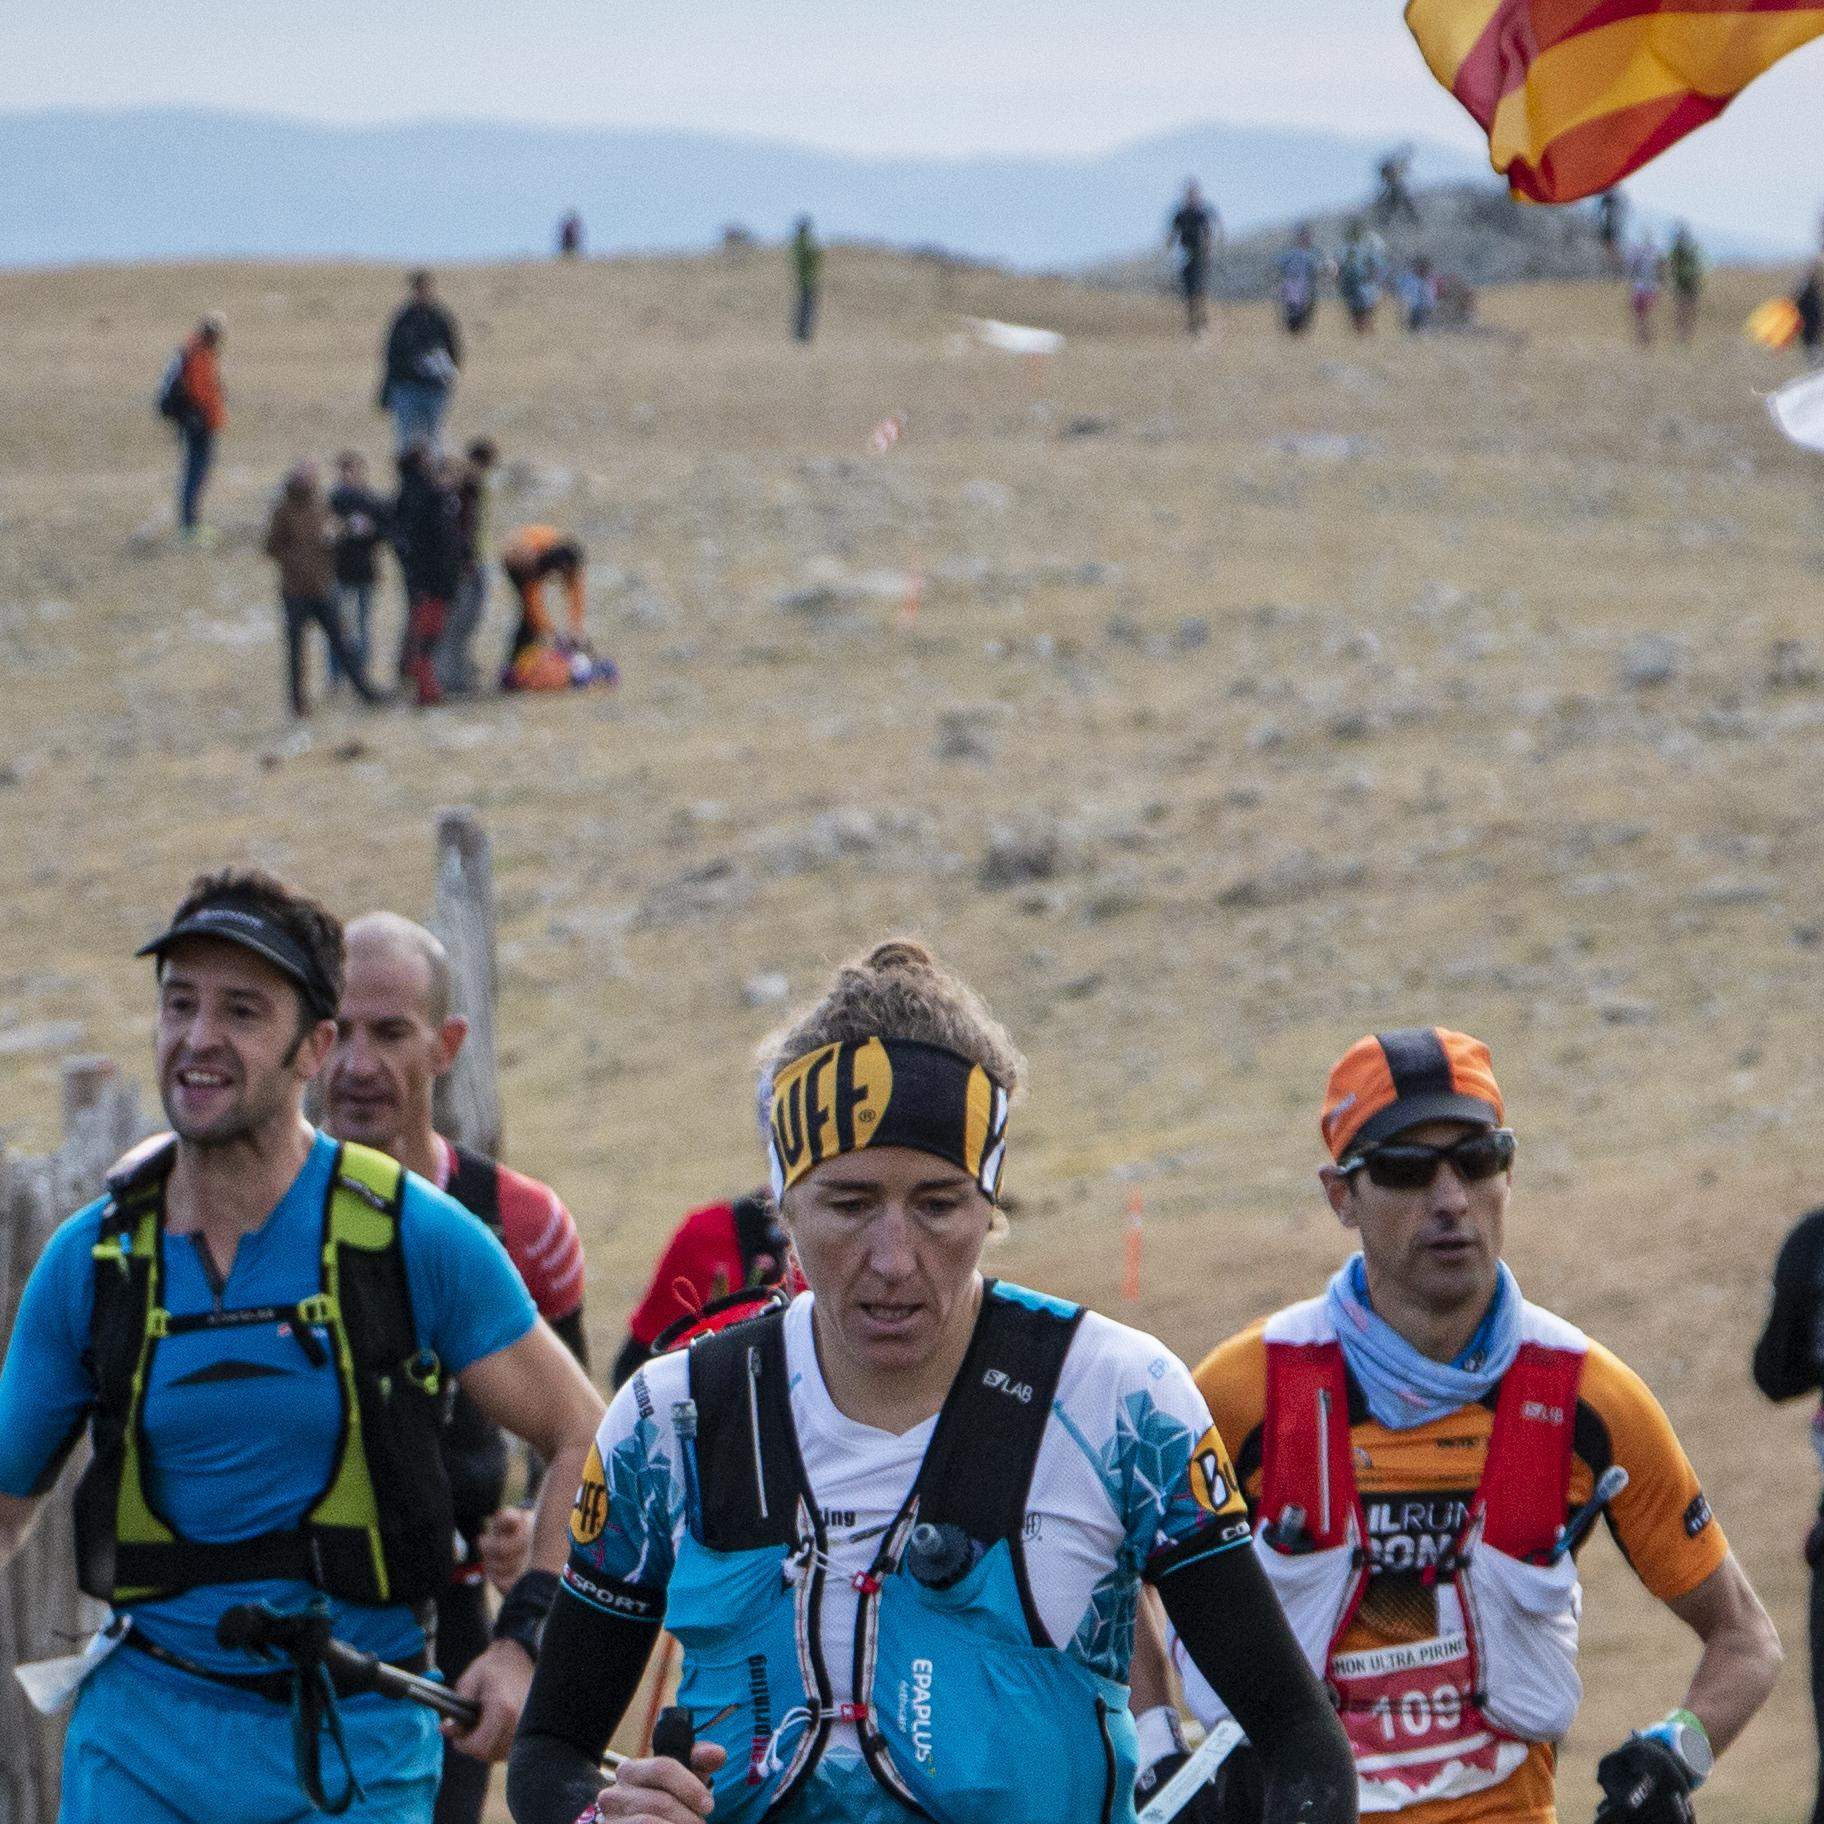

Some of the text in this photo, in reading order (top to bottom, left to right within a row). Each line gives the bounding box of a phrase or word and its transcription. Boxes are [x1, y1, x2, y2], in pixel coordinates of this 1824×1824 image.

[1371, 1649, 1415, 1670] ULTRA
[912, 1659, 933, 1762] EPAPLUS
[1374, 1682, 1471, 1740] 109
